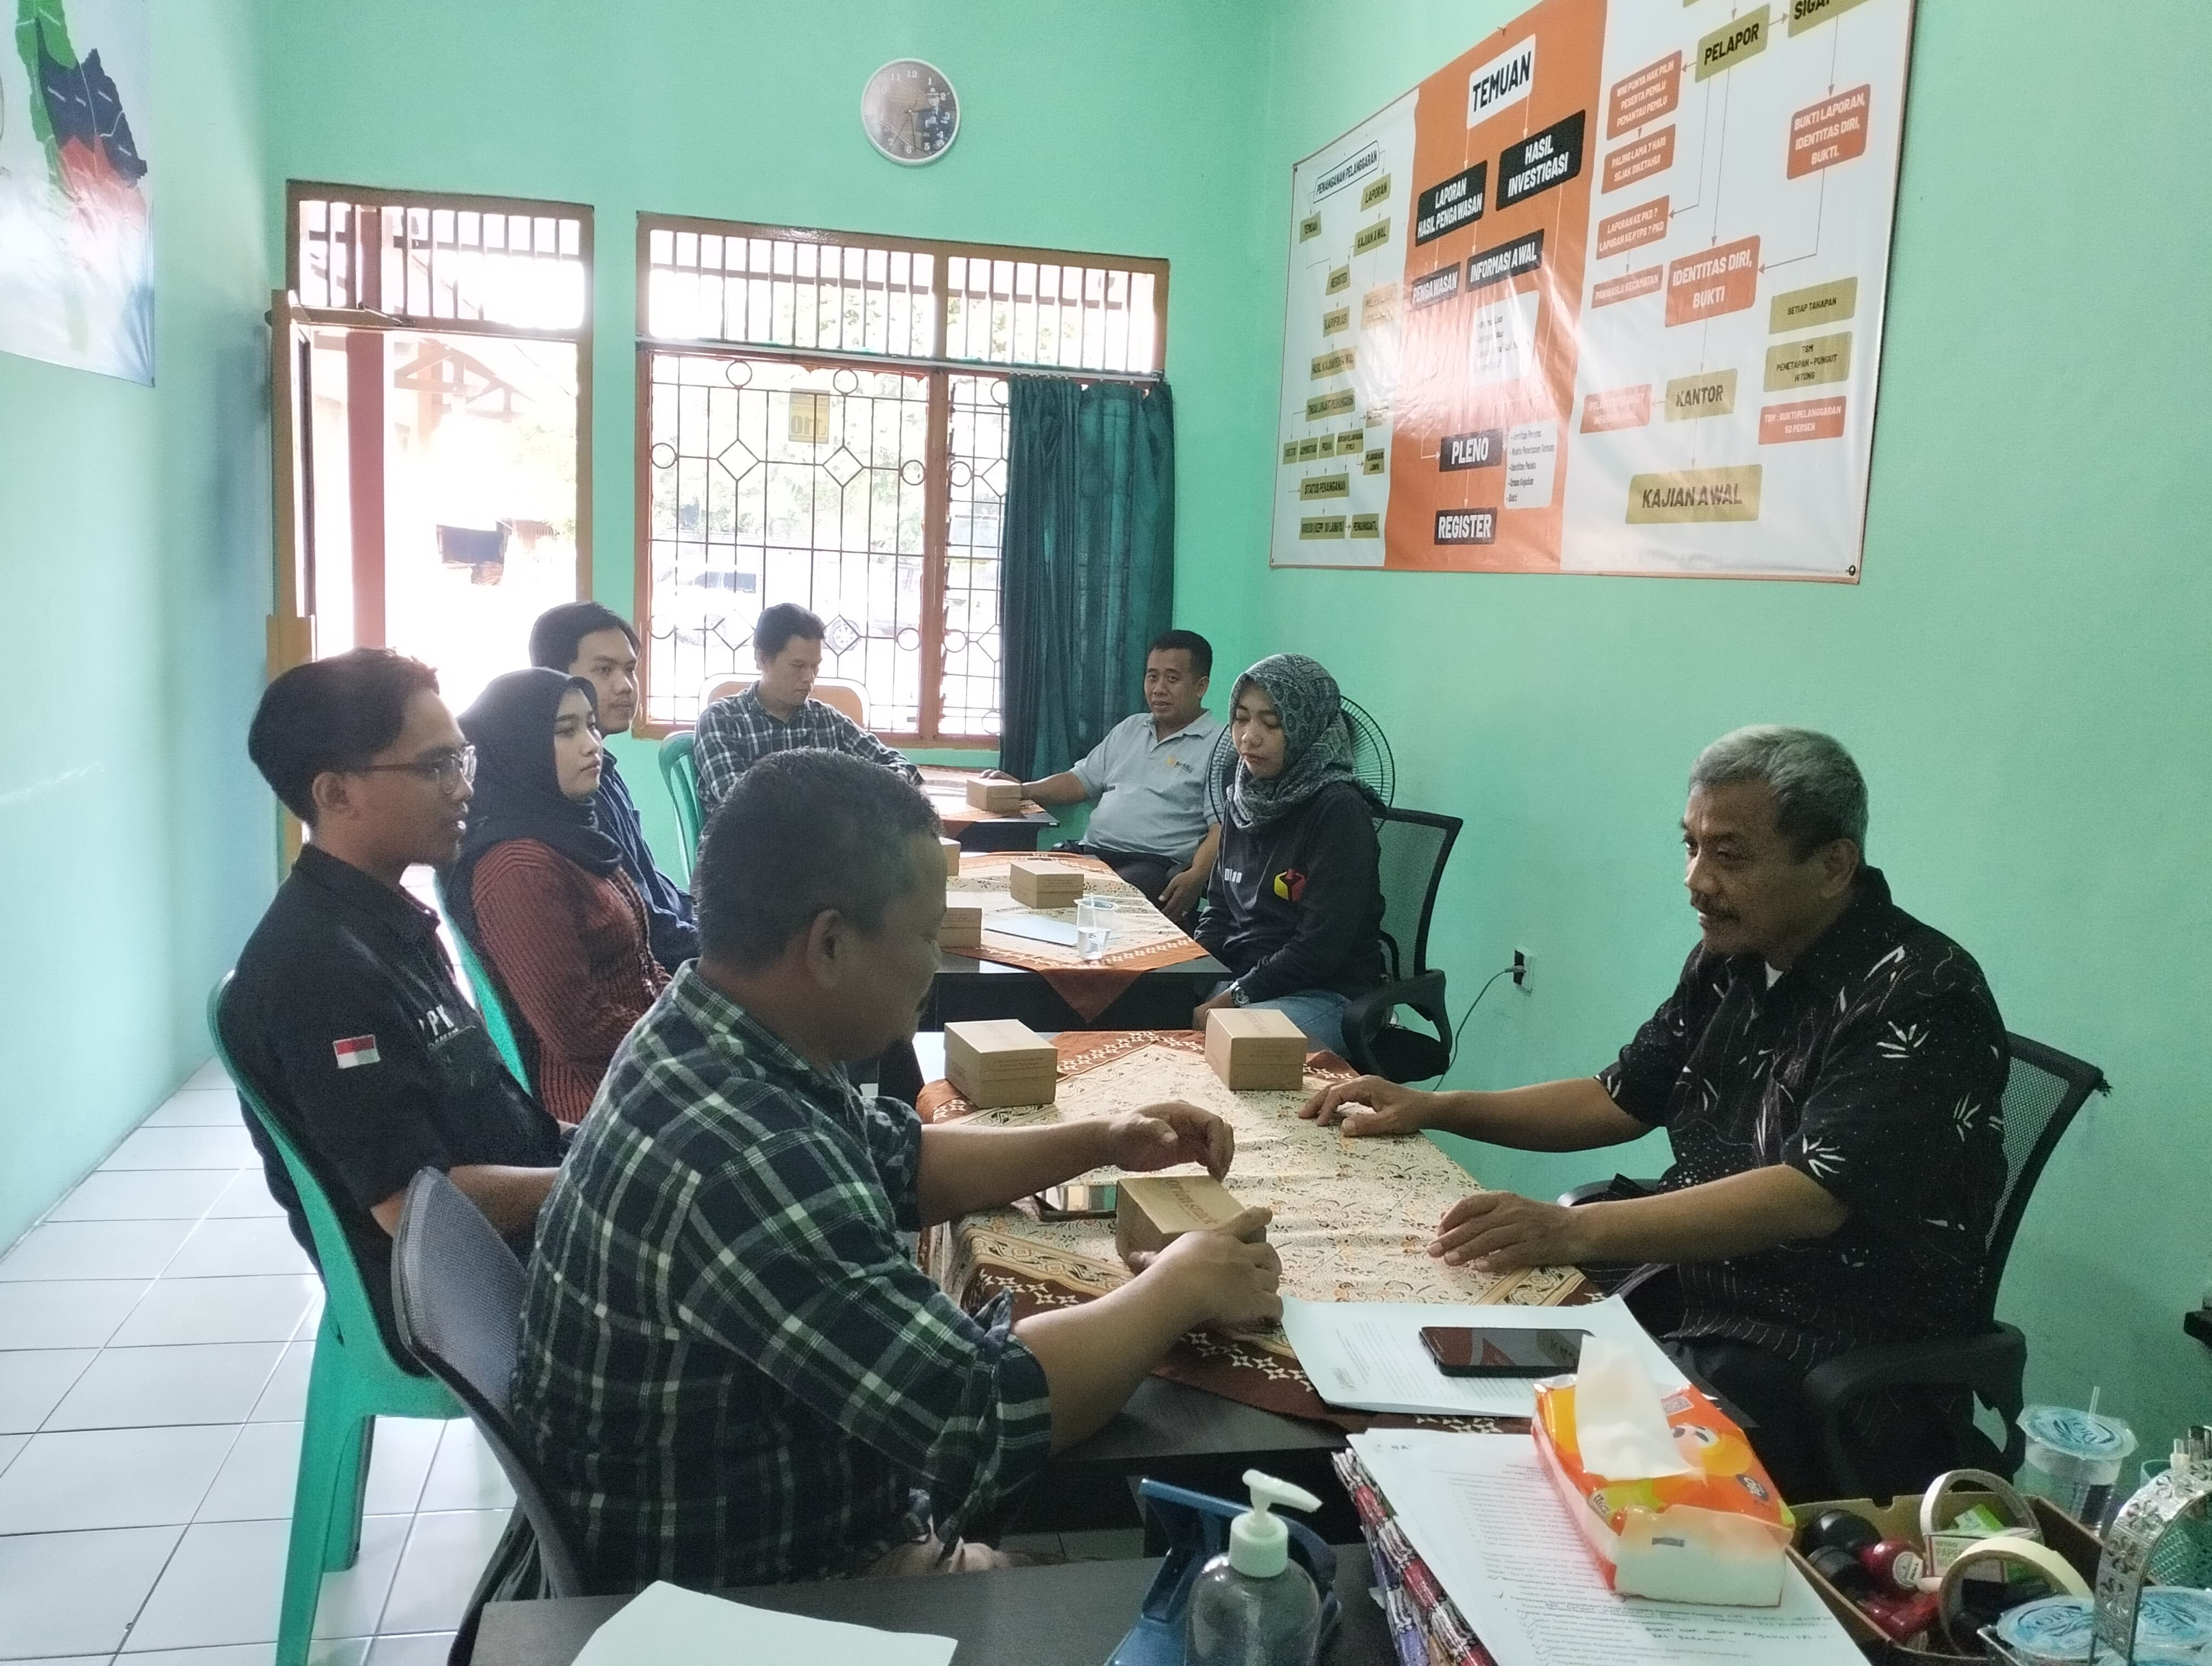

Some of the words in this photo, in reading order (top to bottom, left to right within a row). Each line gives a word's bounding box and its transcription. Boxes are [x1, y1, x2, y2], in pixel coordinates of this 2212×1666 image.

[1794, 0, 1830, 20] SIGA
[1705, 23, 1759, 66] PELAPOR
[1472, 51, 1531, 112] TEMUAN
[1647, 69, 1658, 84] HAK
[1659, 60, 1674, 77] PILIH
[1621, 89, 1645, 110] PESERTA
[1646, 80, 1666, 100] PEMILU
[1617, 105, 1646, 127] PEMANTAU
[1647, 95, 1668, 115] PEMILU
[1795, 110, 1819, 131] BUKTI
[1525, 134, 1553, 165] HASIL
[1796, 124, 1840, 151] IDENTITAS
[1612, 152, 1631, 168] PALING
[1631, 145, 1647, 162] LAMA
[1652, 136, 1666, 150] HARI
[1811, 144, 1840, 165] BUKTI.
[1508, 151, 1569, 198] INVESTIGASI
[1614, 165, 1631, 182] SEJAK
[1632, 154, 1661, 178] DIKETAHUI
[1365, 182, 1387, 203] LAPORAN
[1435, 177, 1467, 209] LAPORAN
[1418, 215, 1436, 239] HASIL
[1436, 193, 1483, 230] PENGAWASAN
[1607, 218, 1634, 234] LAPORAN
[1634, 215, 1642, 226] KE
[1642, 210, 1652, 223] PKD
[1599, 233, 1625, 252] LAPORAN
[1652, 221, 1664, 233] PKD
[1470, 251, 1510, 283] INFORMASI
[1511, 242, 1537, 268] AWAL
[1673, 256, 1726, 287] IDENTITAS
[1728, 249, 1752, 271] DIRI,
[1413, 272, 1457, 304] PENGAWASAN
[1693, 286, 1725, 309] BUKTI
[1787, 303, 1808, 315] SETIAP
[1809, 298, 1836, 311] TAHAPAN
[1777, 358, 1809, 371] PENETAPAN
[1814, 354, 1837, 367] PUNGUT
[1795, 372, 1815, 382] HITUNG
[1676, 385, 1724, 407] KANTOR
[1779, 411, 1796, 421] BUKTI
[1796, 406, 1841, 419] PELANGGARAN
[1793, 422, 1815, 433] PERSEN
[1451, 438, 1489, 464] PLENO
[1642, 486, 1695, 508] KAJIAN
[1697, 484, 1742, 505] AWAL
[1438, 514, 1491, 539] REGISTER
